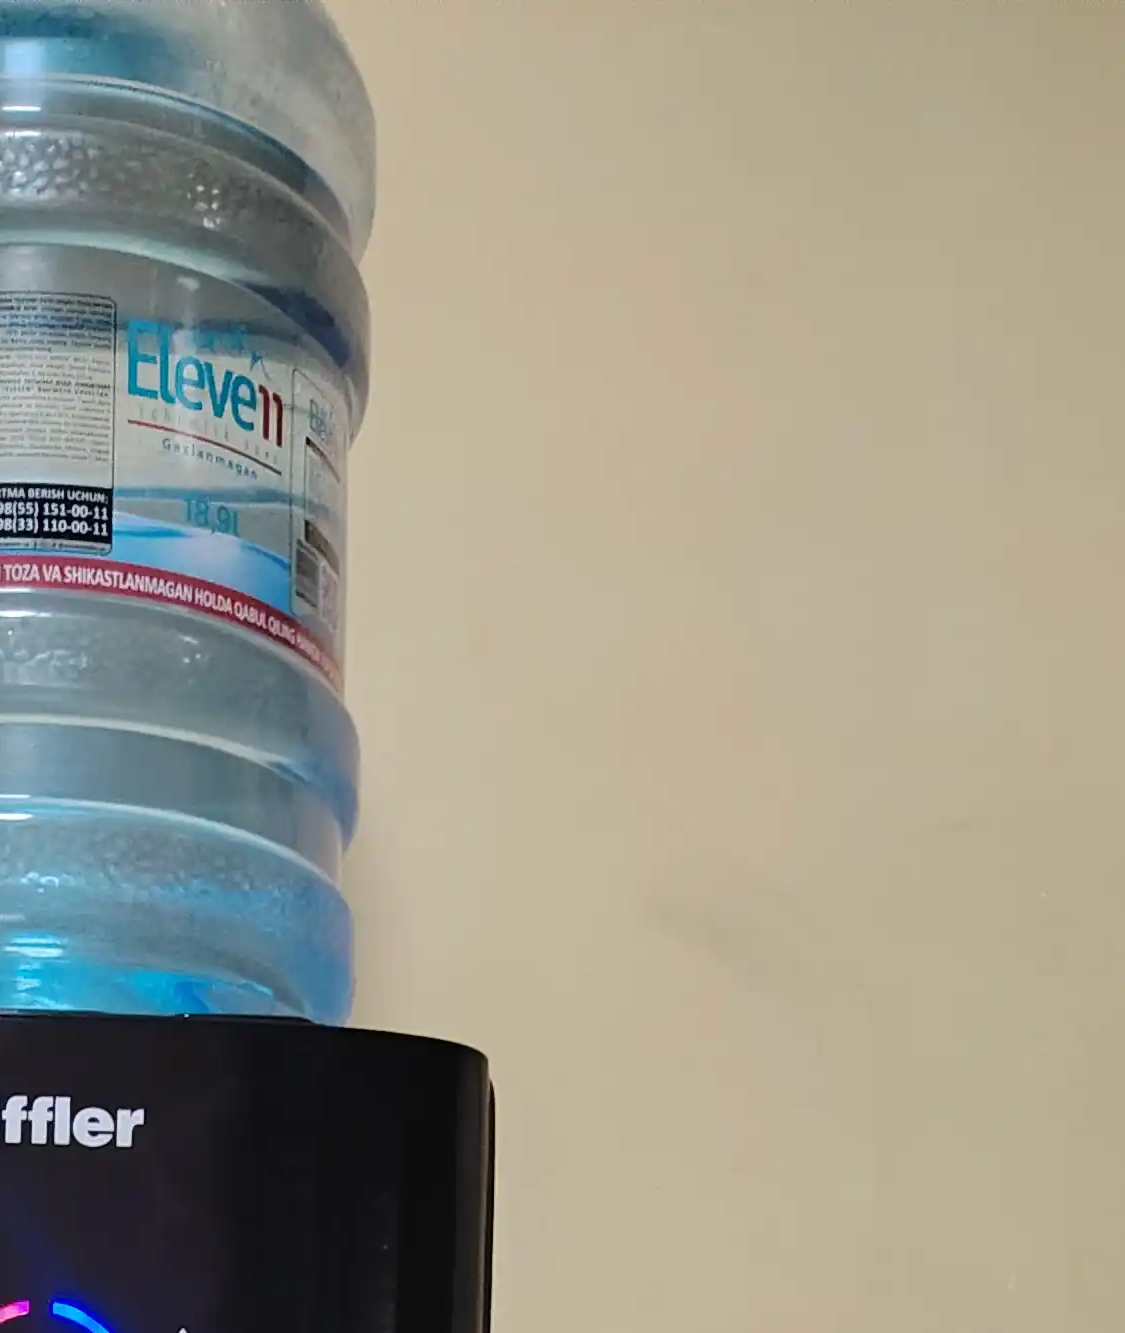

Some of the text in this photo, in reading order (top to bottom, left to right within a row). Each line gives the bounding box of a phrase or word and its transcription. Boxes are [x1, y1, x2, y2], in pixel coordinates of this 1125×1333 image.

[28, 488, 65, 501] BERISH
[43, 503, 109, 521] 151-00-11
[43, 518, 109, 537] 110-00-11
[3, 563, 41, 583] TOZA
[42, 564, 62, 583] VA
[63, 565, 193, 603] SHIKASTLANMAGAN
[194, 587, 233, 615] HOLDA
